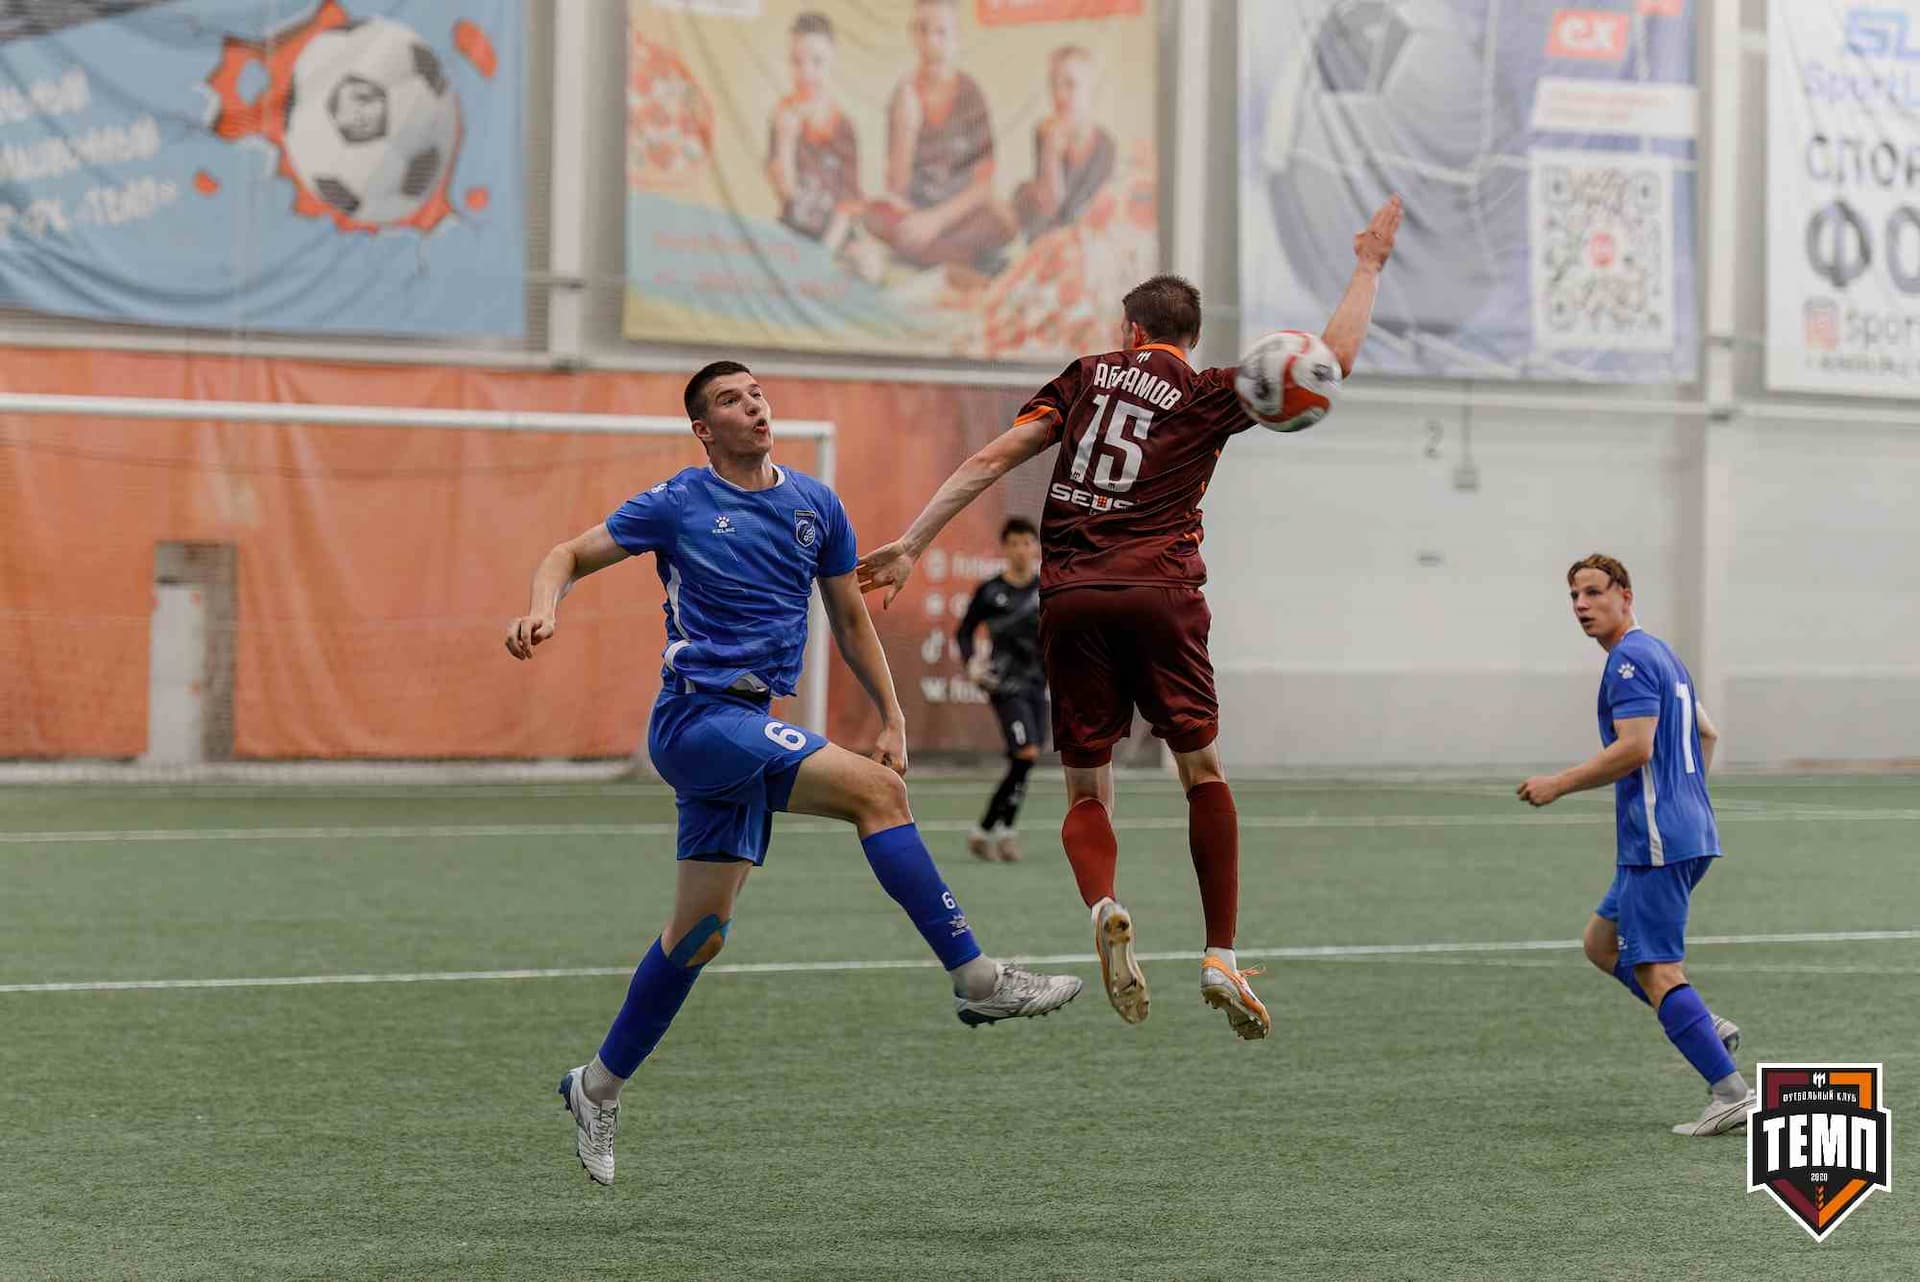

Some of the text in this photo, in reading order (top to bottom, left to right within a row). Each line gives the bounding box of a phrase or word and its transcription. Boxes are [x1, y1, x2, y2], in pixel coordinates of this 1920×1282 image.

[1070, 394, 1154, 492] 15
[764, 721, 807, 751] 6
[941, 891, 956, 910] 6
